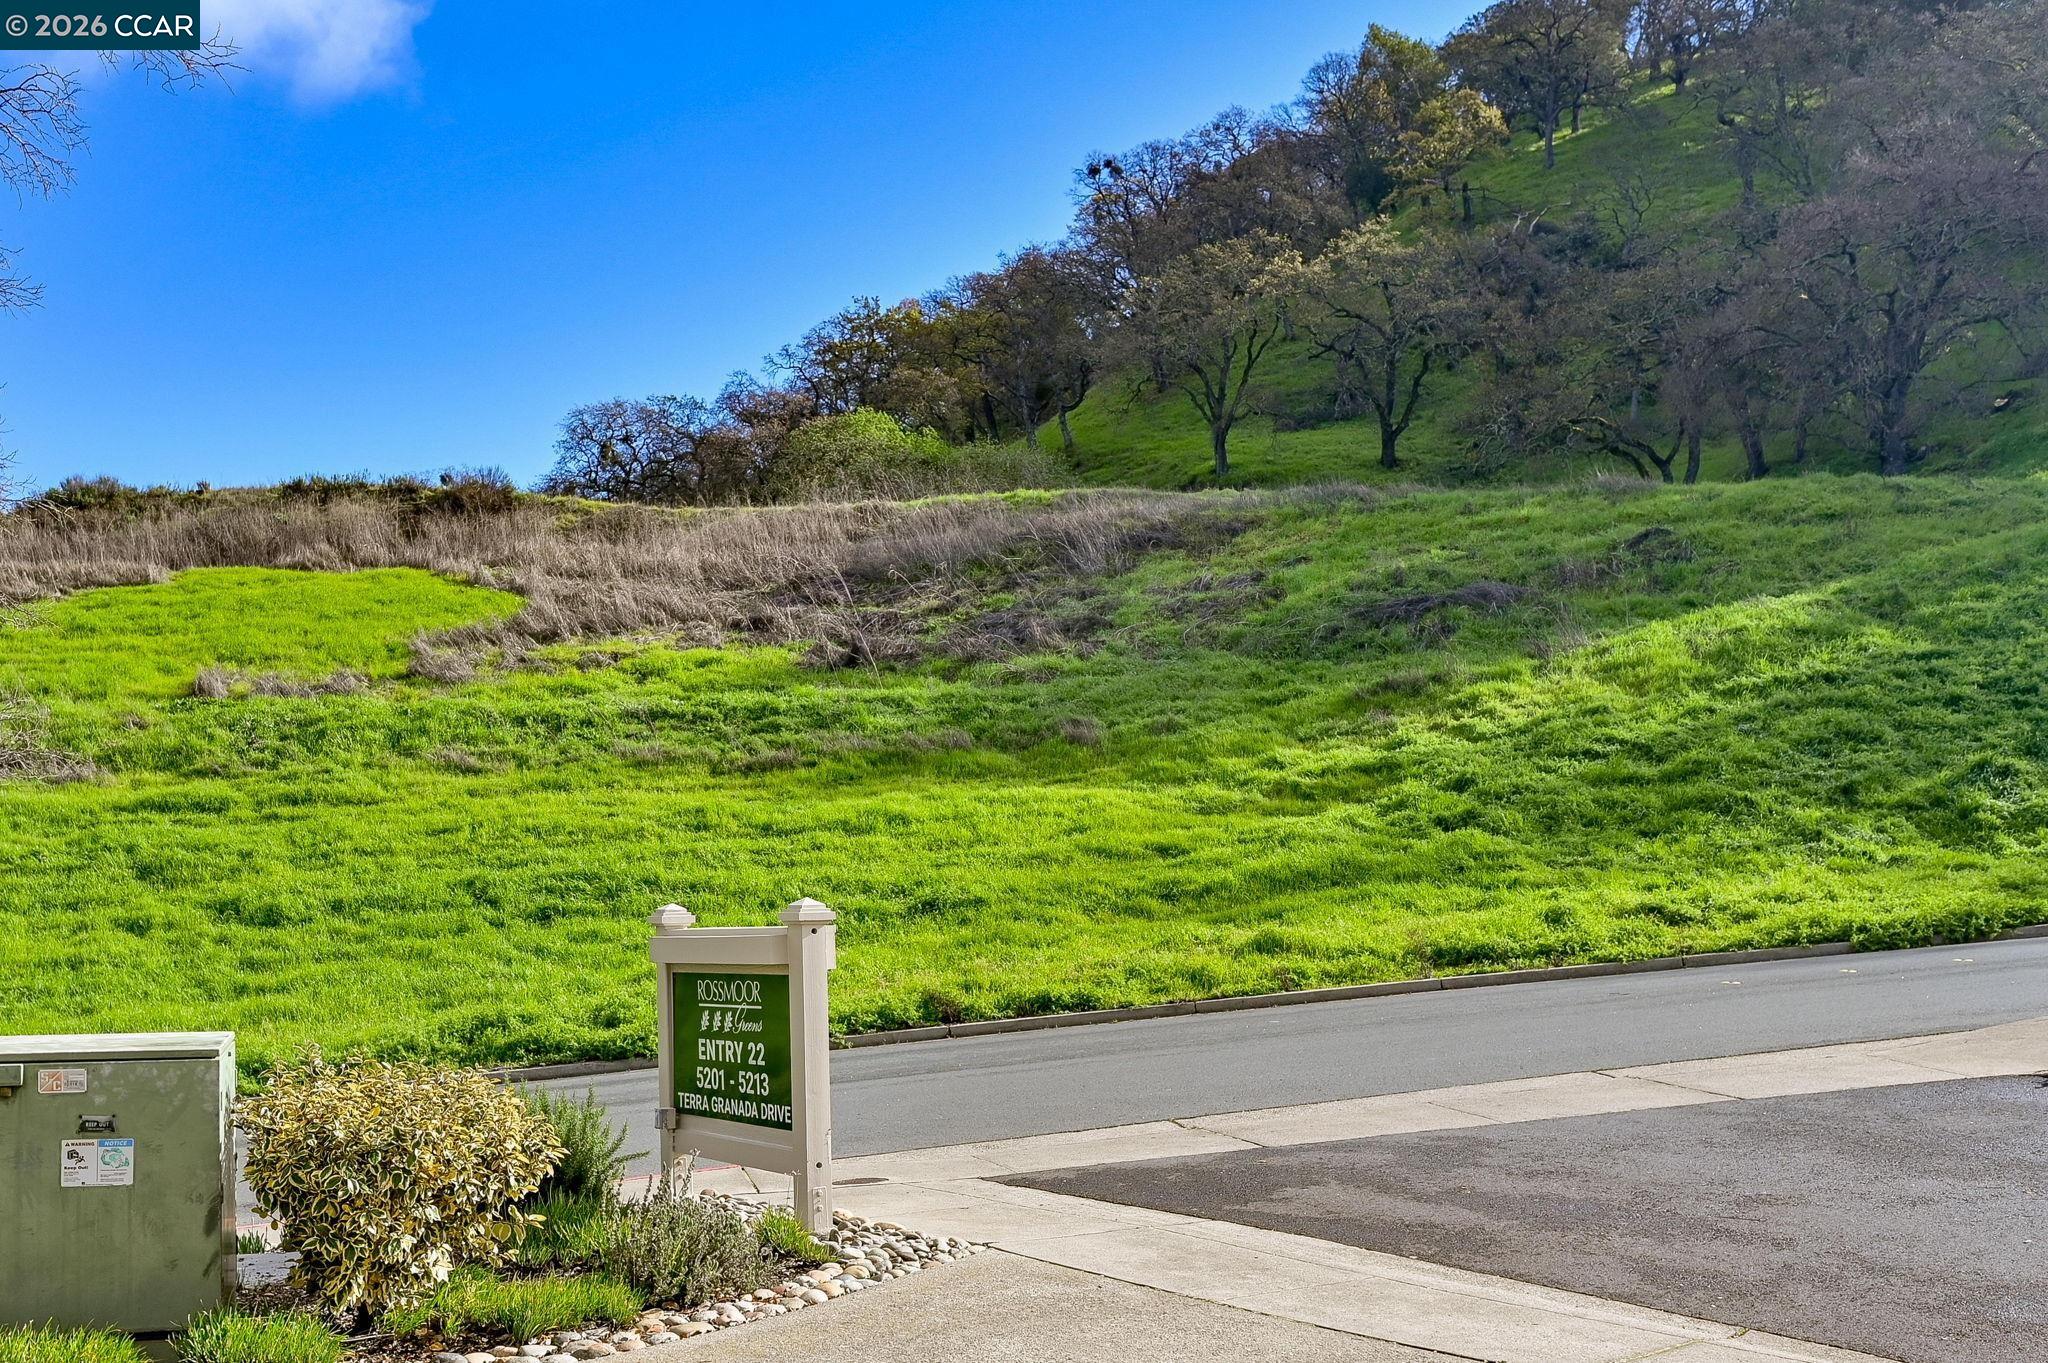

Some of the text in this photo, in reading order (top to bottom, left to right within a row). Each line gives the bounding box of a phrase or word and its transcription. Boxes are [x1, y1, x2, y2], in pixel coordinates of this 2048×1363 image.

[697, 979, 762, 1003] ROSSMOOR
[733, 1003, 763, 1034] Greens
[698, 1038, 766, 1066] ENTRY 22
[696, 1066, 725, 1090] 5201
[738, 1070, 770, 1096] 5213
[677, 1091, 792, 1124] TERRA GRANADA DRIVE
